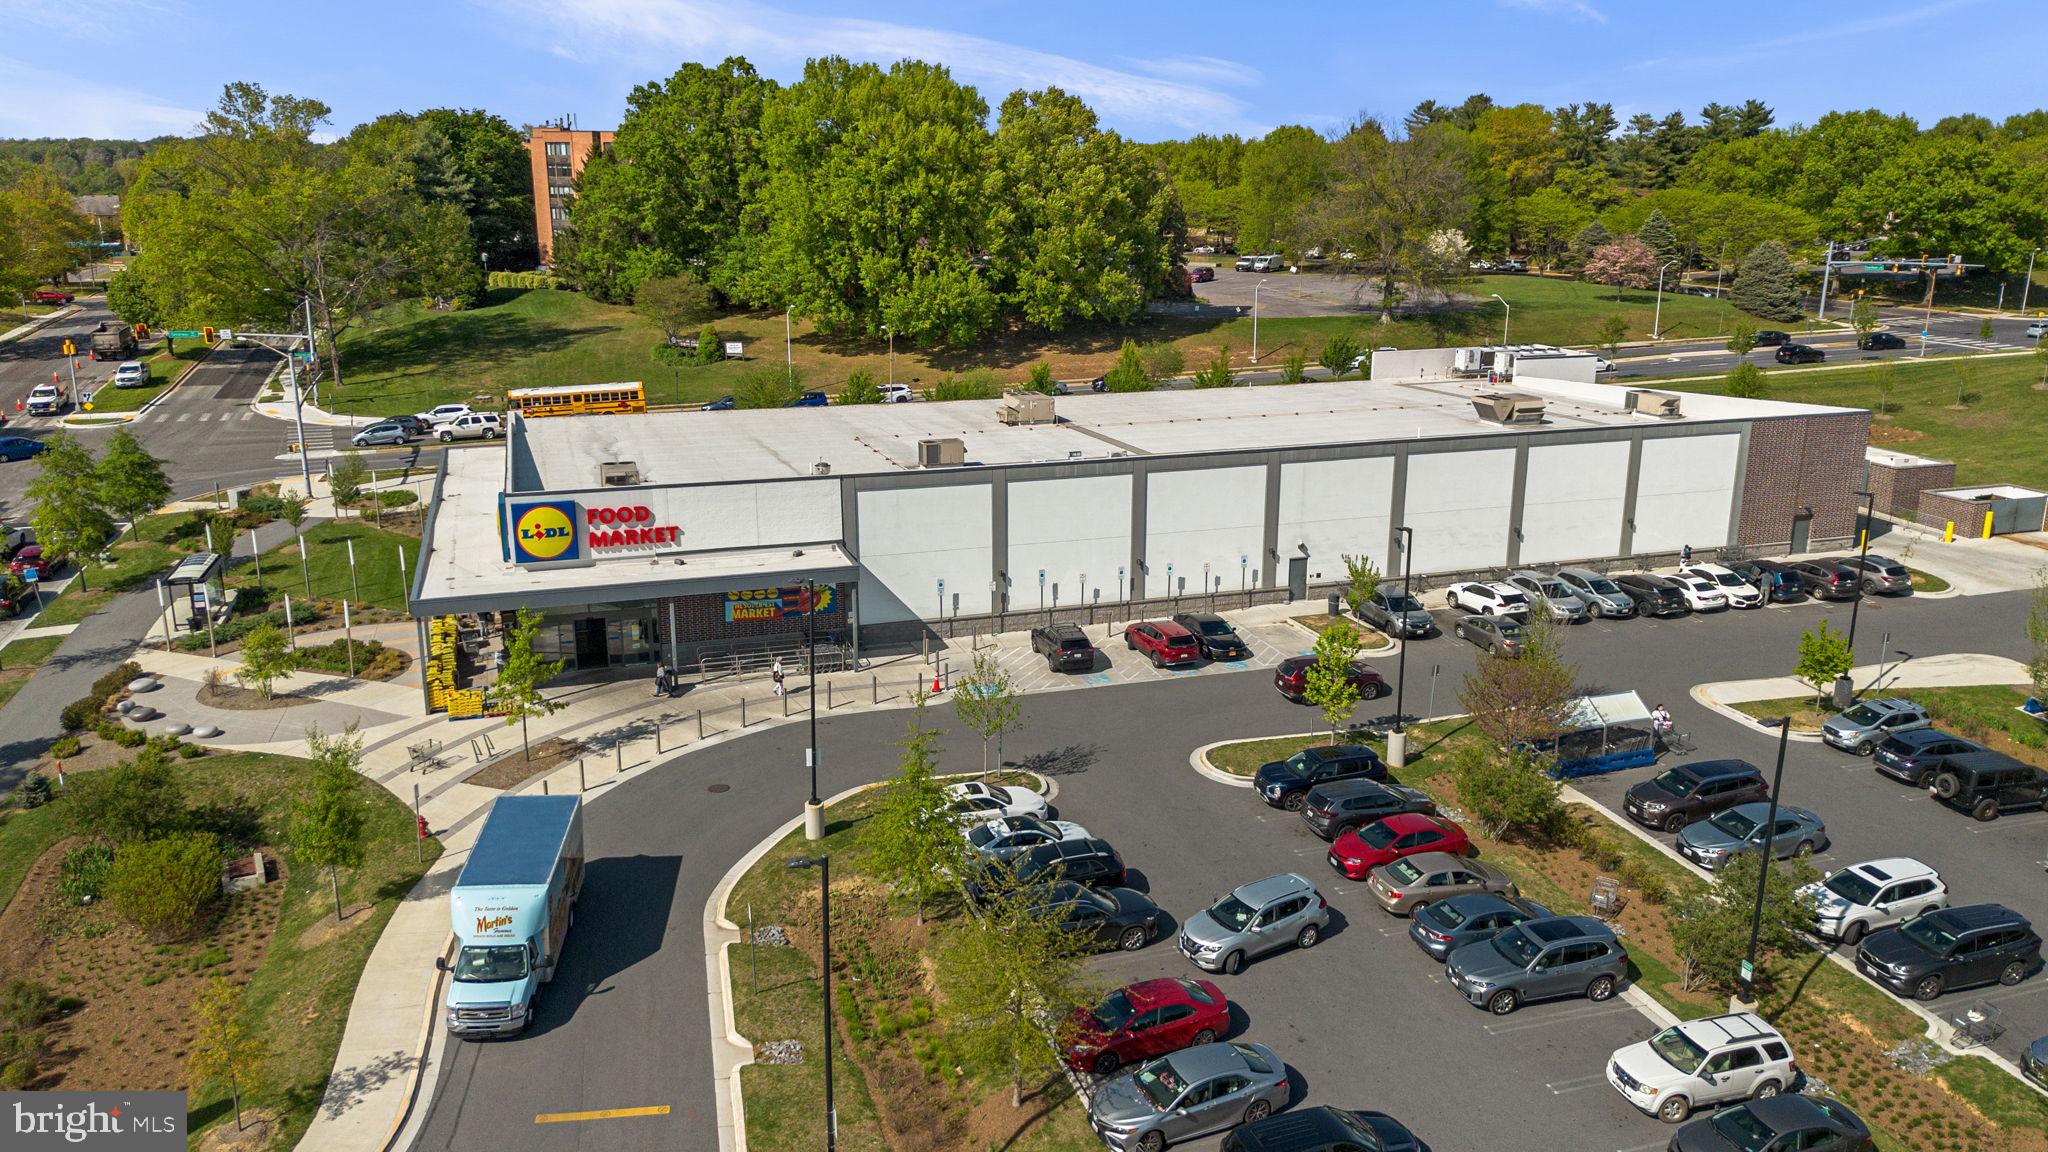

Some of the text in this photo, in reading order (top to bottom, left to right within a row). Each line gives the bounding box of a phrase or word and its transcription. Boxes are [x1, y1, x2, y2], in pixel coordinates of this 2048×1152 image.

[587, 505, 650, 525] FOOD
[589, 526, 679, 548] MARKET
[733, 607, 776, 619] MARKET
[477, 915, 512, 933] Martin's
